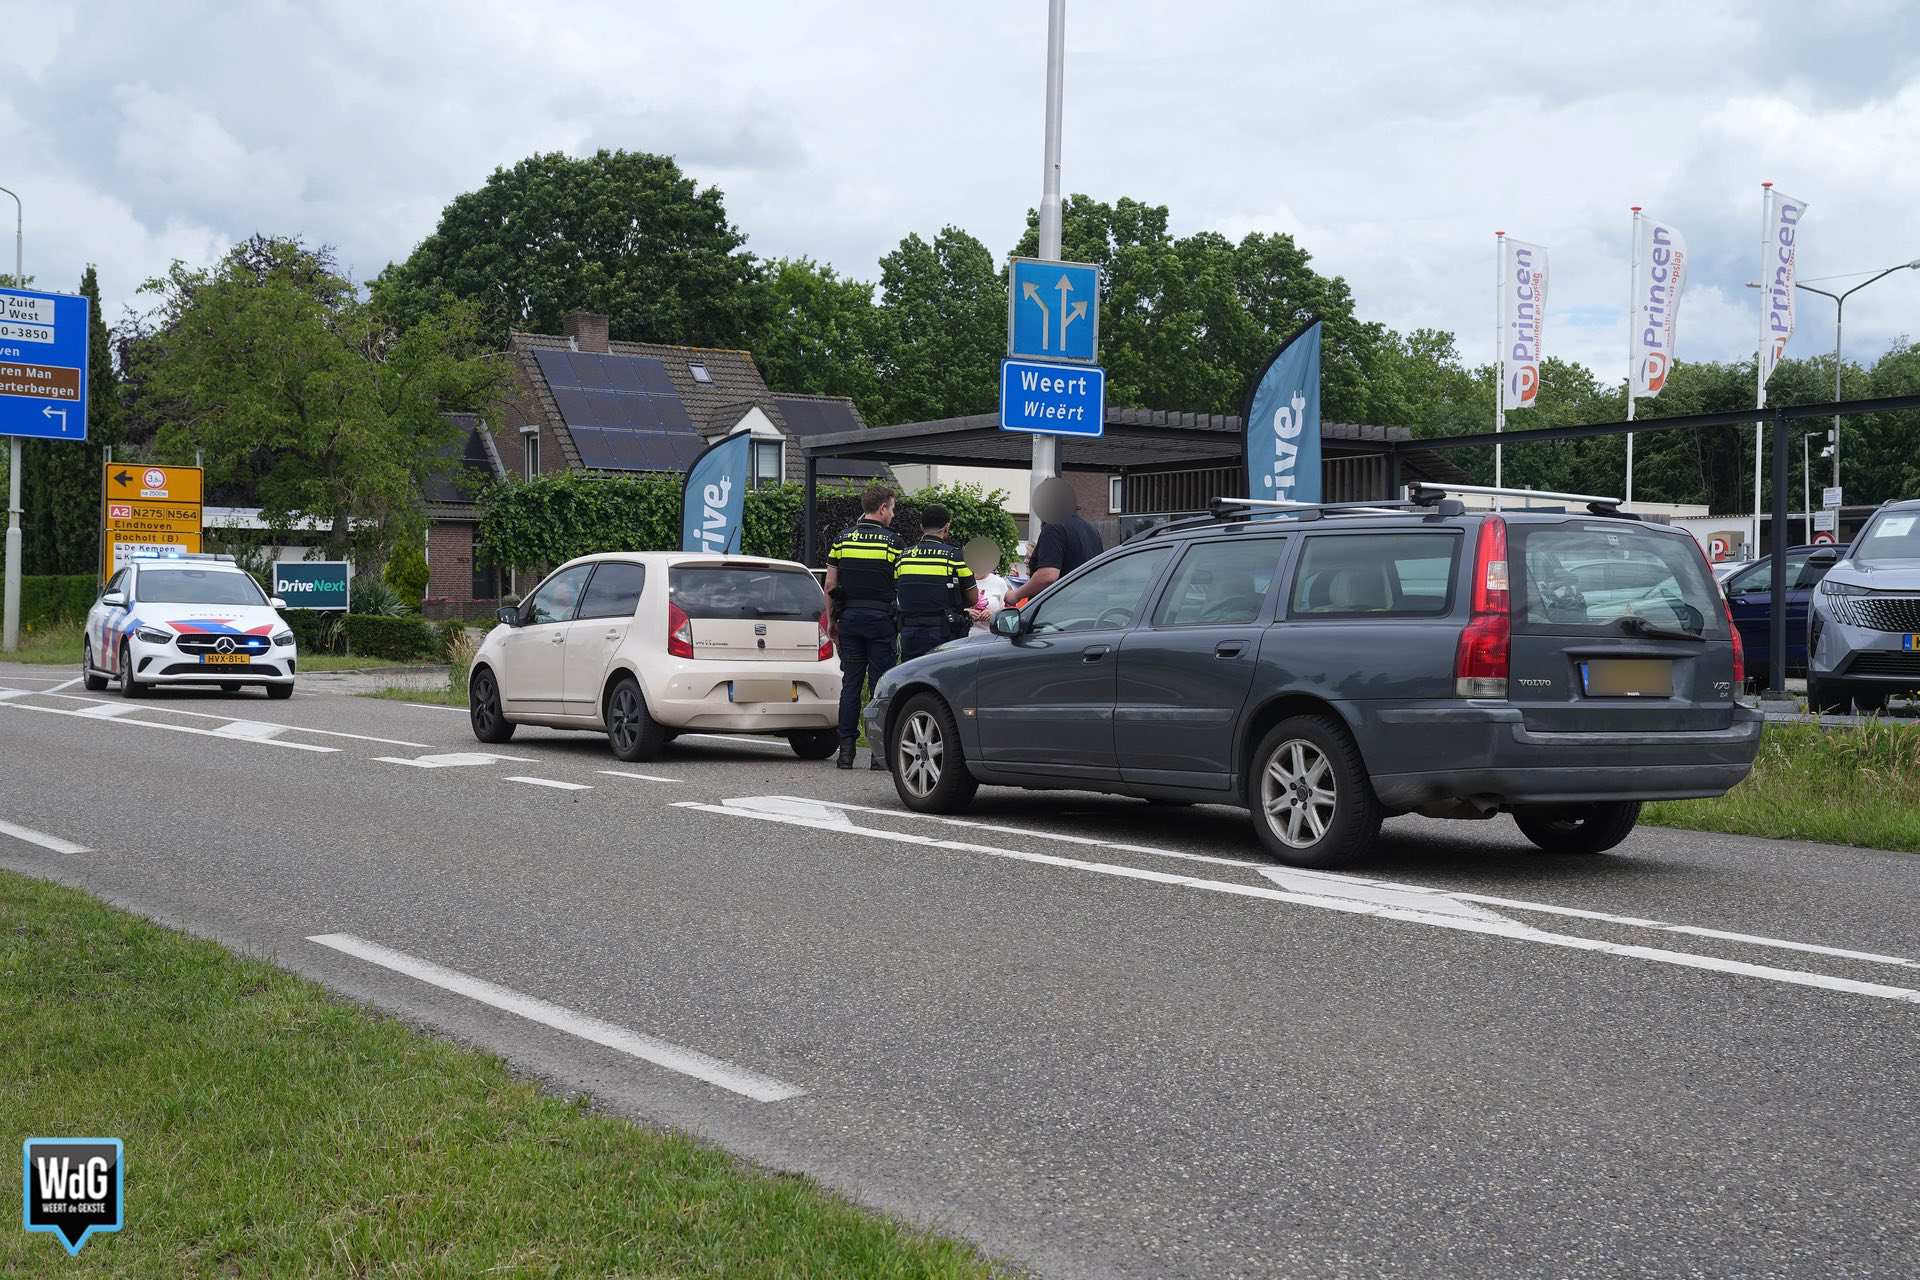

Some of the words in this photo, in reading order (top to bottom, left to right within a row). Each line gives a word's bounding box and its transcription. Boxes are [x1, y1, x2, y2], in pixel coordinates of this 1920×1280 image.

[1770, 204, 1798, 332] Princen
[1644, 226, 1671, 348] Princen
[9, 297, 35, 309] Zuid
[1512, 248, 1534, 362] Princen
[9, 310, 39, 321] West
[1, 326, 48, 340] 0-3850
[1, 367, 21, 377] ren
[26, 368, 52, 379] Man
[1021, 370, 1087, 396] Weert
[1024, 400, 1084, 421] Wieërt
[112, 507, 129, 517] A2
[133, 509, 163, 518] N275
[167, 510, 197, 519] N564
[114, 520, 172, 530] Eindhoven
[114, 533, 156, 542] Bocholt
[162, 534, 180, 543] (B)
[278, 579, 345, 592] DriveNext
[208, 655, 246, 663] HVX-81-L
[1518, 679, 1552, 687] VOLVO
